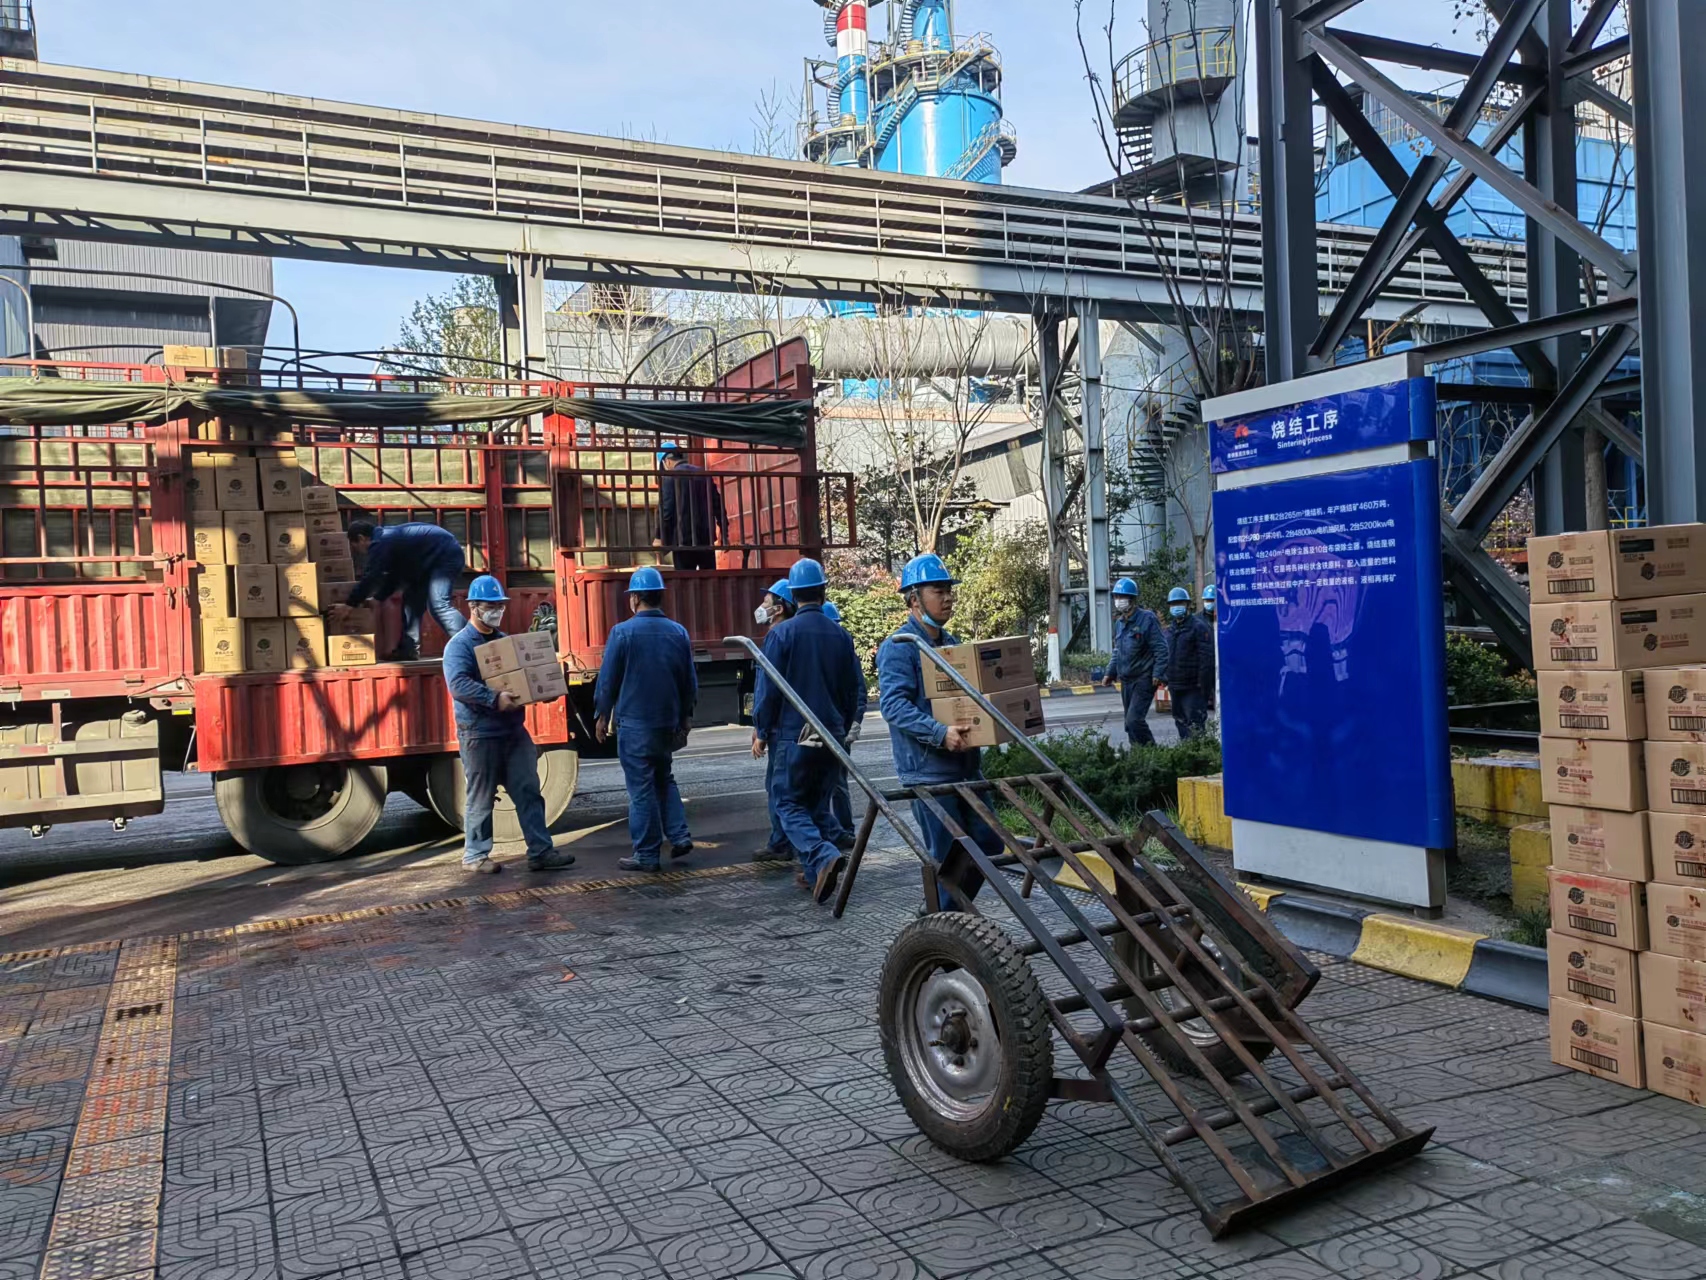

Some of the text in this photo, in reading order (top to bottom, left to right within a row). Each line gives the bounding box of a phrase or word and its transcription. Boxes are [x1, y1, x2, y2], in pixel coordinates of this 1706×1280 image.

[1271, 409, 1339, 440] 烧结工序
[1277, 434, 1333, 449] Sintering process
